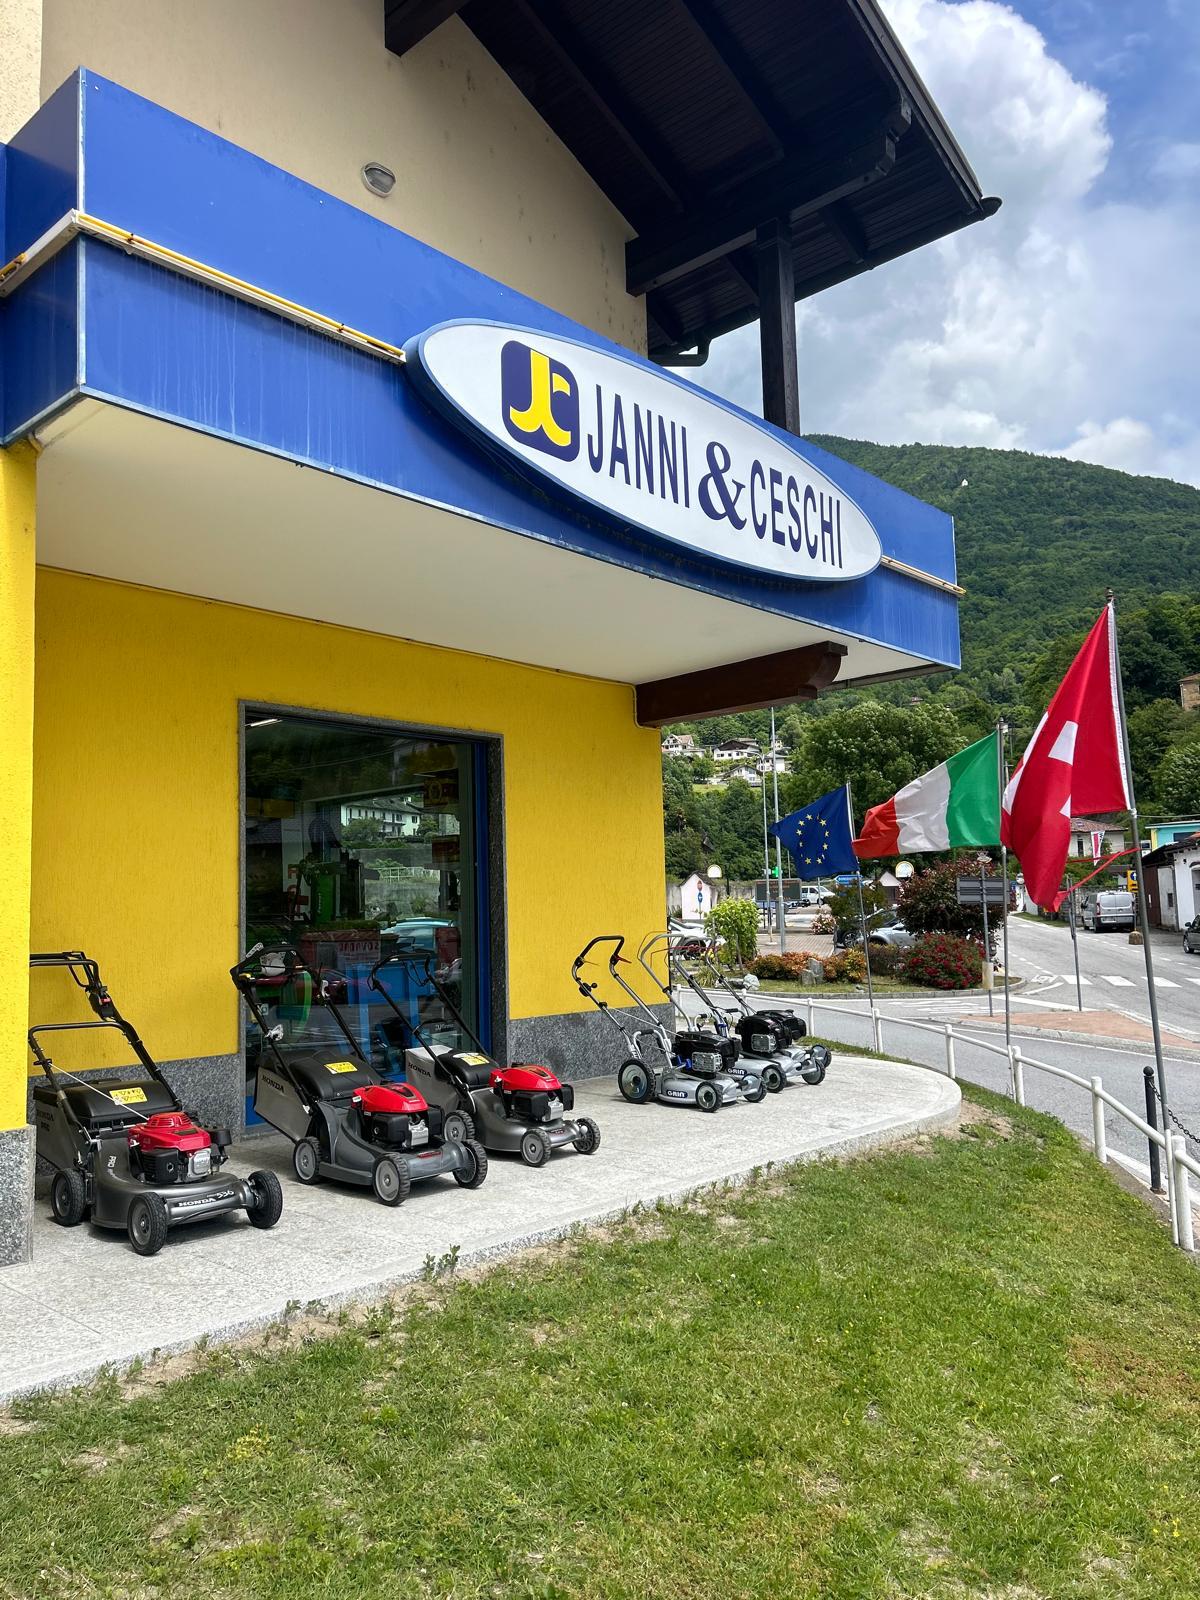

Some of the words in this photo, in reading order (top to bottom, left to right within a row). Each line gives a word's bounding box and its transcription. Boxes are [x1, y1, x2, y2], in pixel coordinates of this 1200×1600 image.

[587, 384, 690, 509] JANNI
[698, 441, 747, 531] &
[750, 459, 844, 569] CESCHI
[407, 1061, 432, 1078] HONDA
[261, 1074, 285, 1094] HONDA
[177, 1197, 216, 1208] HONDA
